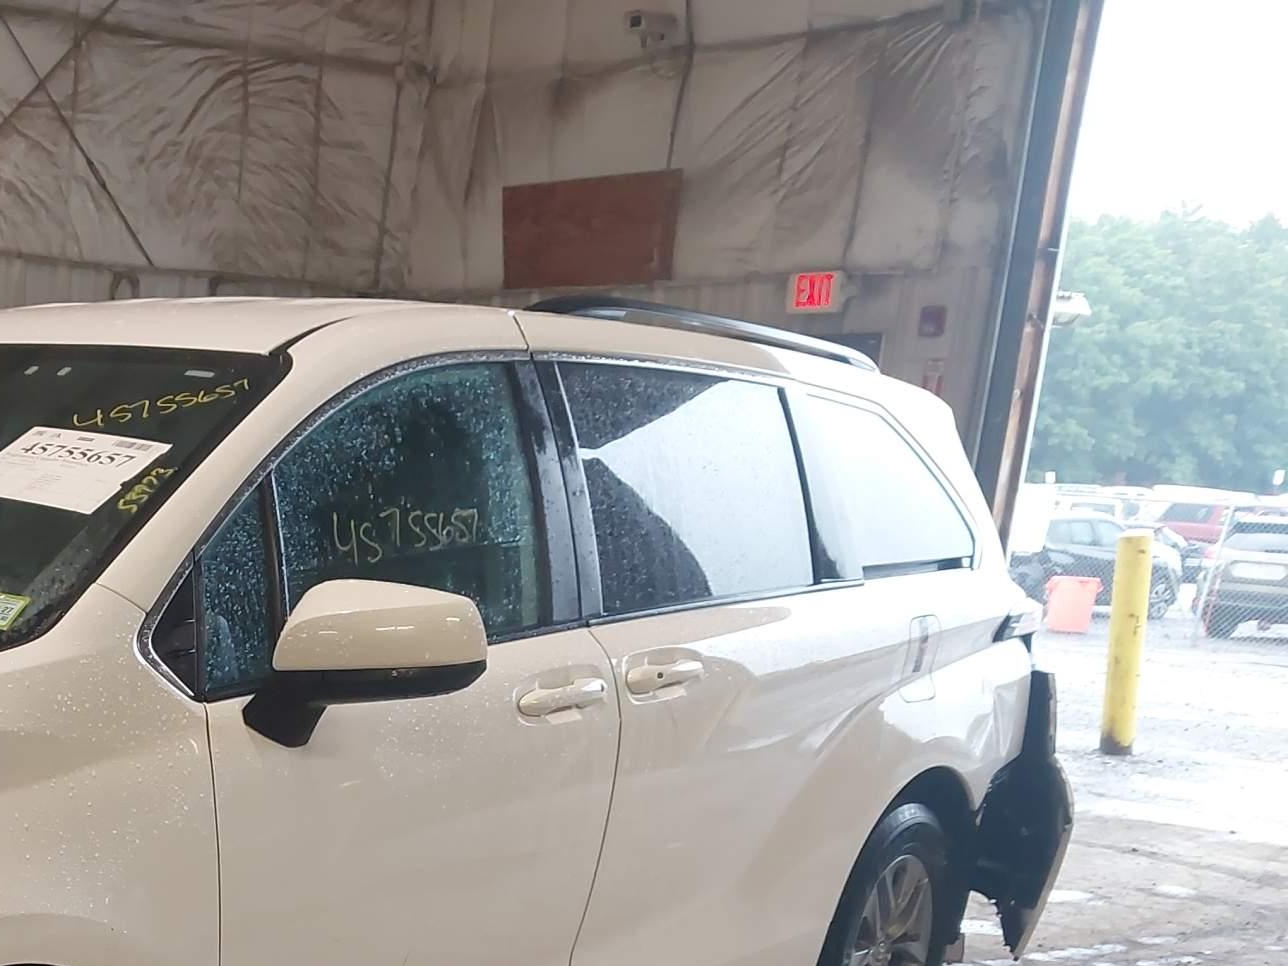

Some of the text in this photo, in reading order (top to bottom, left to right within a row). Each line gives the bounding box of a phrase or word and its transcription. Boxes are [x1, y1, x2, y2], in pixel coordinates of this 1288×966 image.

[794, 273, 835, 308] EXIT
[72, 378, 250, 427] 45755657
[21, 441, 137, 468] 45755657
[332, 507, 479, 567] 45755657
